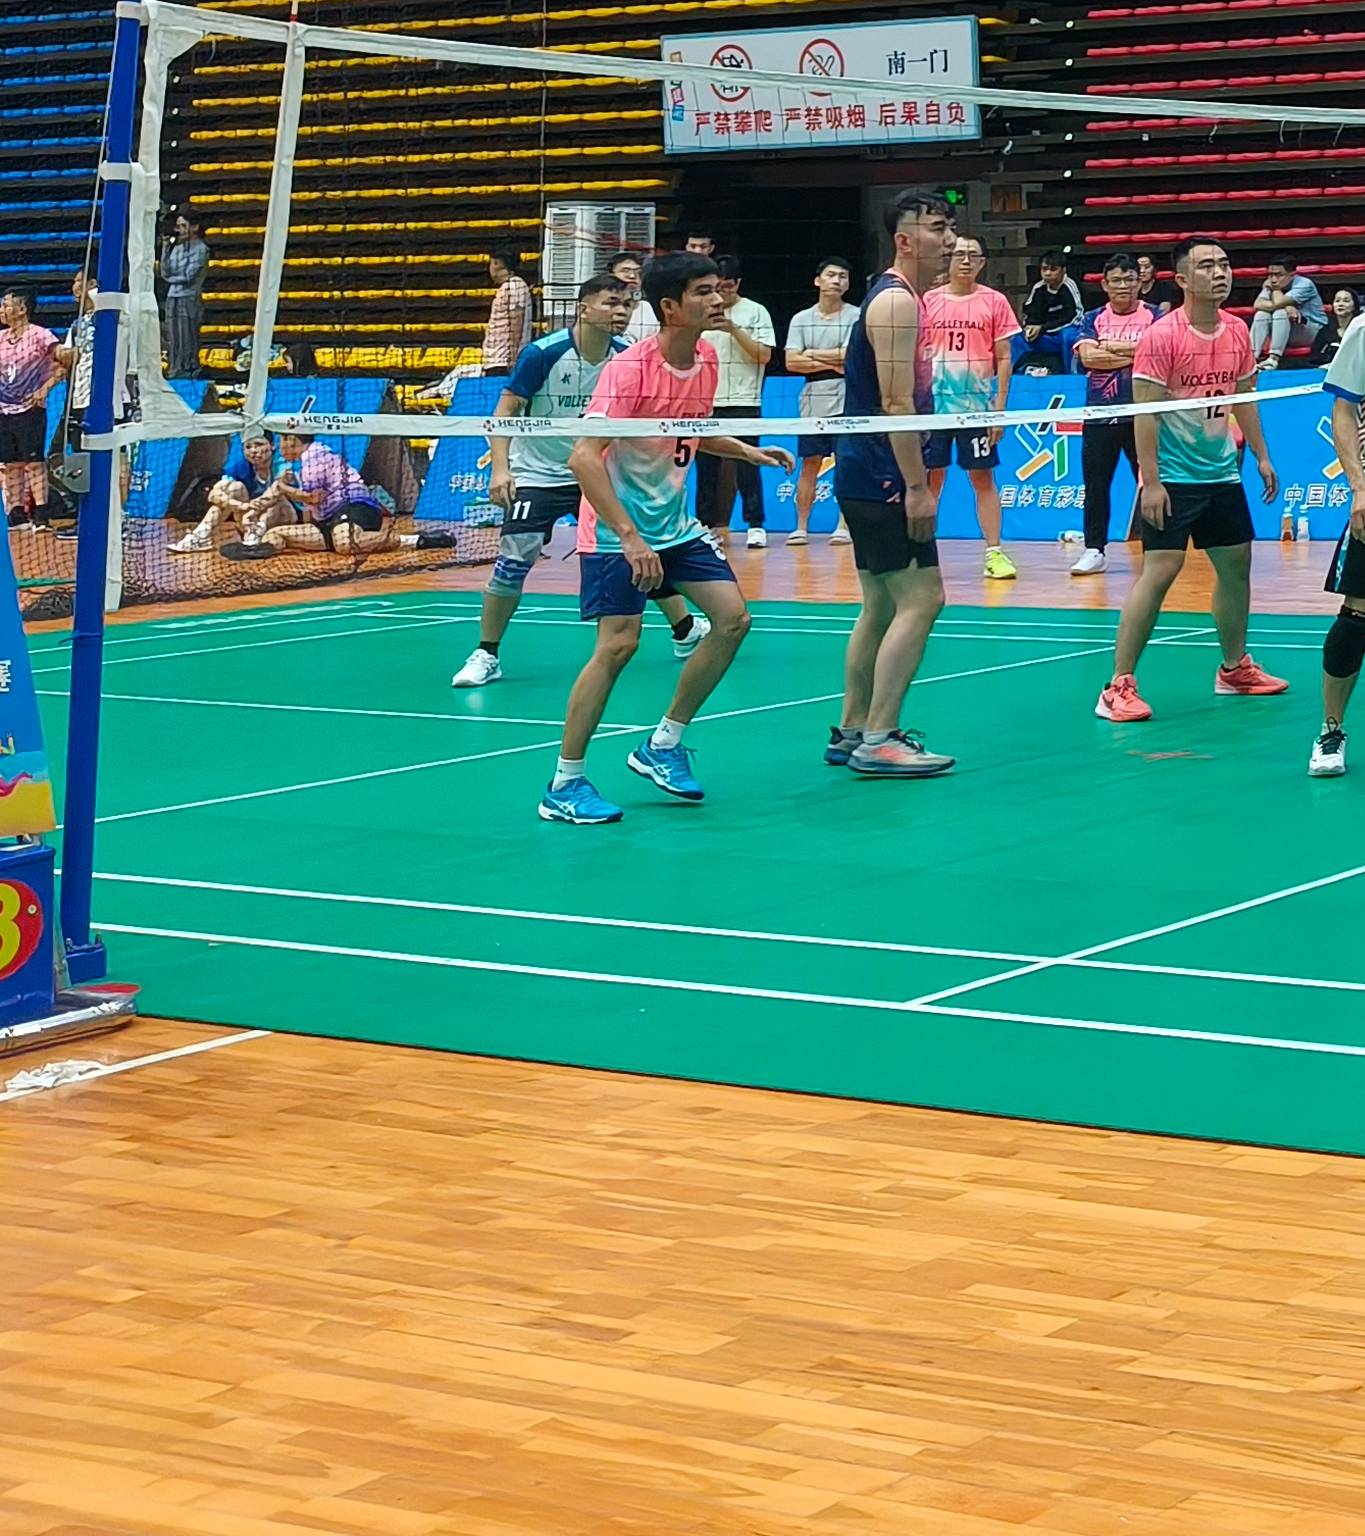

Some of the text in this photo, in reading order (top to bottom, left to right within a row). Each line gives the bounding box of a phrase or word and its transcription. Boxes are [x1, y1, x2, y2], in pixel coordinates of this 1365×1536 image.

[886, 49, 949, 76] 南一门
[695, 101, 966, 136] 严禁攀爬 严禁吸烟 后果自负
[948, 331, 966, 351] 13
[303, 415, 363, 424] HENGJIA
[497, 419, 552, 427] HENGJIA
[674, 436, 692, 467] 5
[971, 436, 991, 458] 13
[776, 479, 834, 502] 中体
[1284, 483, 1351, 507] 中国体
[512, 500, 531, 520] 11
